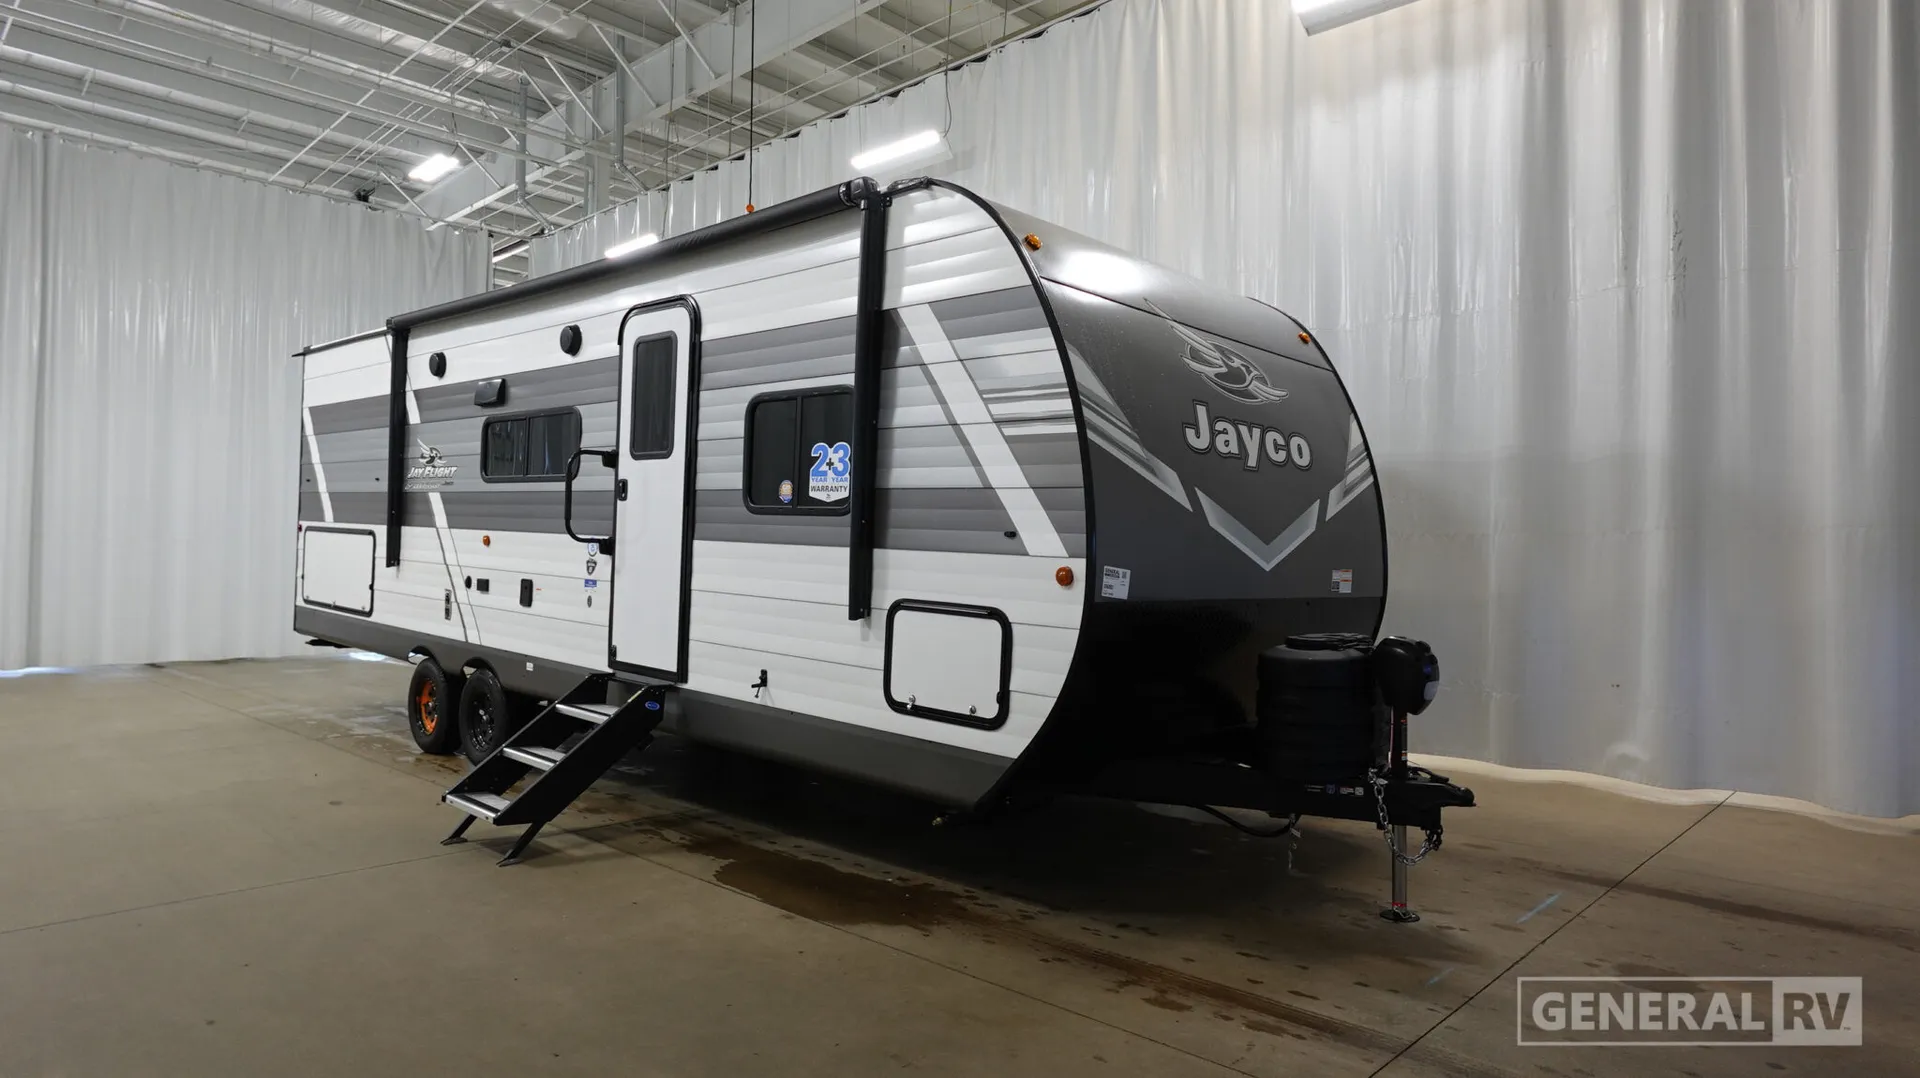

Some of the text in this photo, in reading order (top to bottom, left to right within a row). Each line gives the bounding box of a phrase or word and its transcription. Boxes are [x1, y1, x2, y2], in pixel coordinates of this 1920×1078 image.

[1183, 402, 1312, 470] Jayco
[407, 466, 458, 478] JAY FLIGHT
[810, 485, 848, 493] WARRANTY
